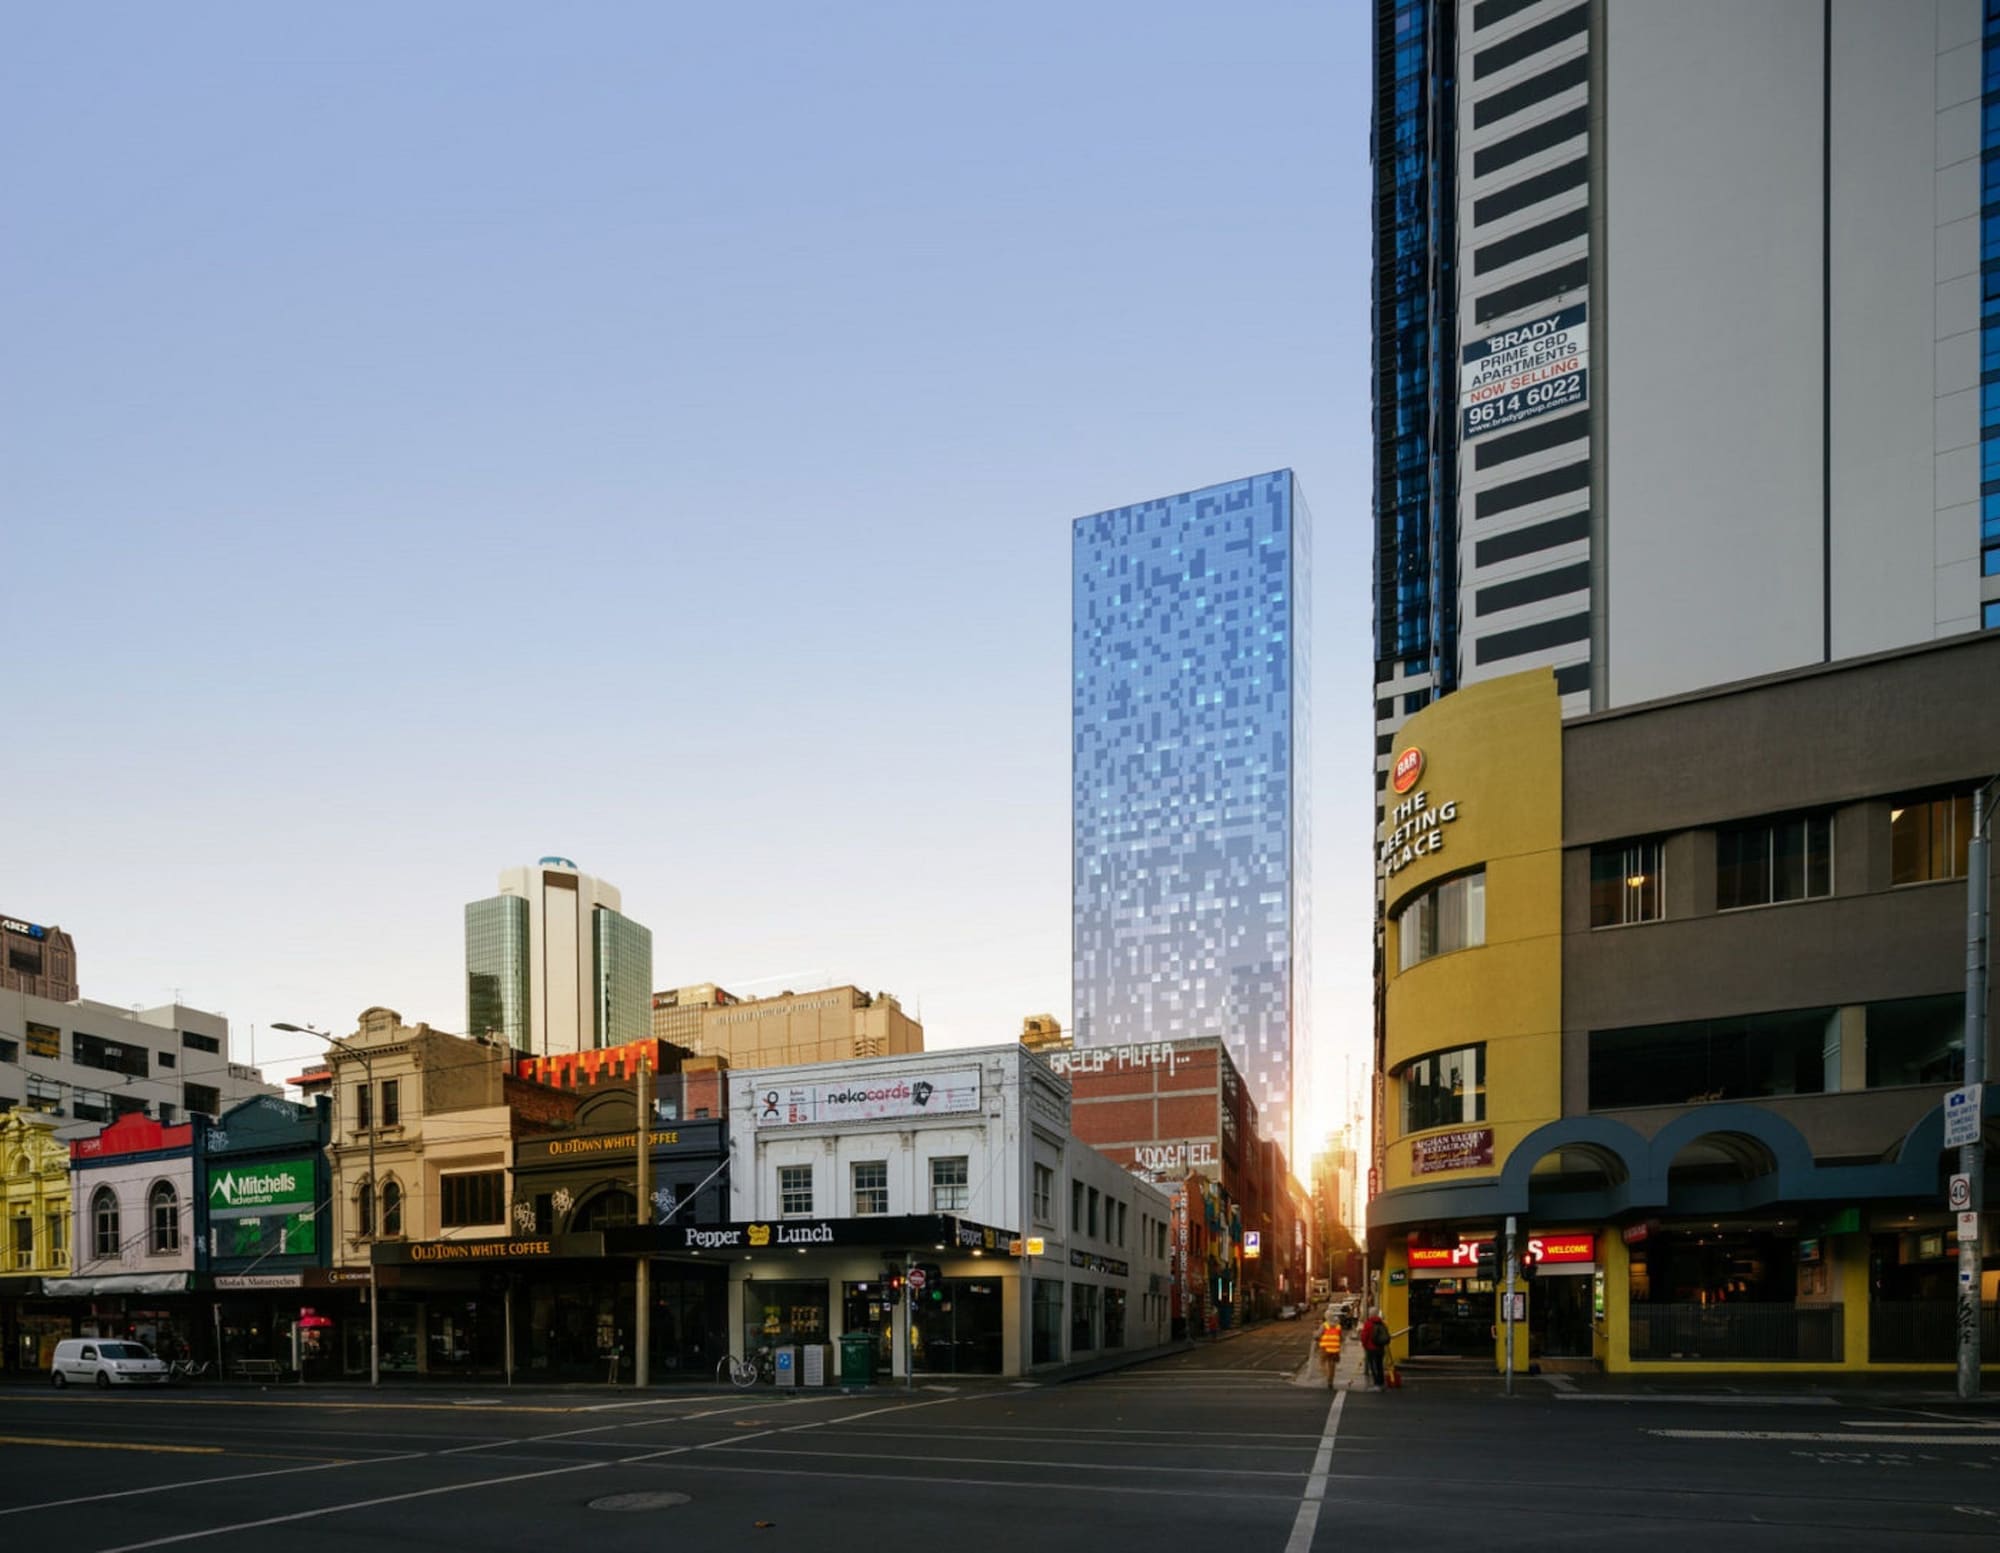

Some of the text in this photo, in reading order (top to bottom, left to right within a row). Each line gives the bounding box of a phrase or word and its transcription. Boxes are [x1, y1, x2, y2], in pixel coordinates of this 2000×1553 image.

[1490, 316, 1560, 353] BRADY
[1472, 343, 1577, 387] APARTMENTS
[1481, 333, 1568, 372] PRIME CBD
[1470, 358, 1579, 404] NOW SELLING
[1469, 375, 1580, 425] 9614 6022
[1469, 393, 1581, 433] www.bradygroup.com.au
[1397, 751, 1418, 777] BAR
[1392, 790, 1426, 825] THE
[828, 1082, 910, 1105] nekocards
[603, 1135, 638, 1150] WHITE
[238, 1172, 296, 1195] Mitchells
[1952, 1184, 1965, 1199] 40
[230, 1194, 273, 1205] adventure
[685, 1227, 741, 1248] Pepper
[777, 1223, 834, 1244] Lunch
[470, 1243, 507, 1257] WHITE
[508, 1241, 551, 1255] COFFEE
[1547, 1245, 1589, 1255] WELCOME
[248, 1277, 297, 1288] Motorcycles
